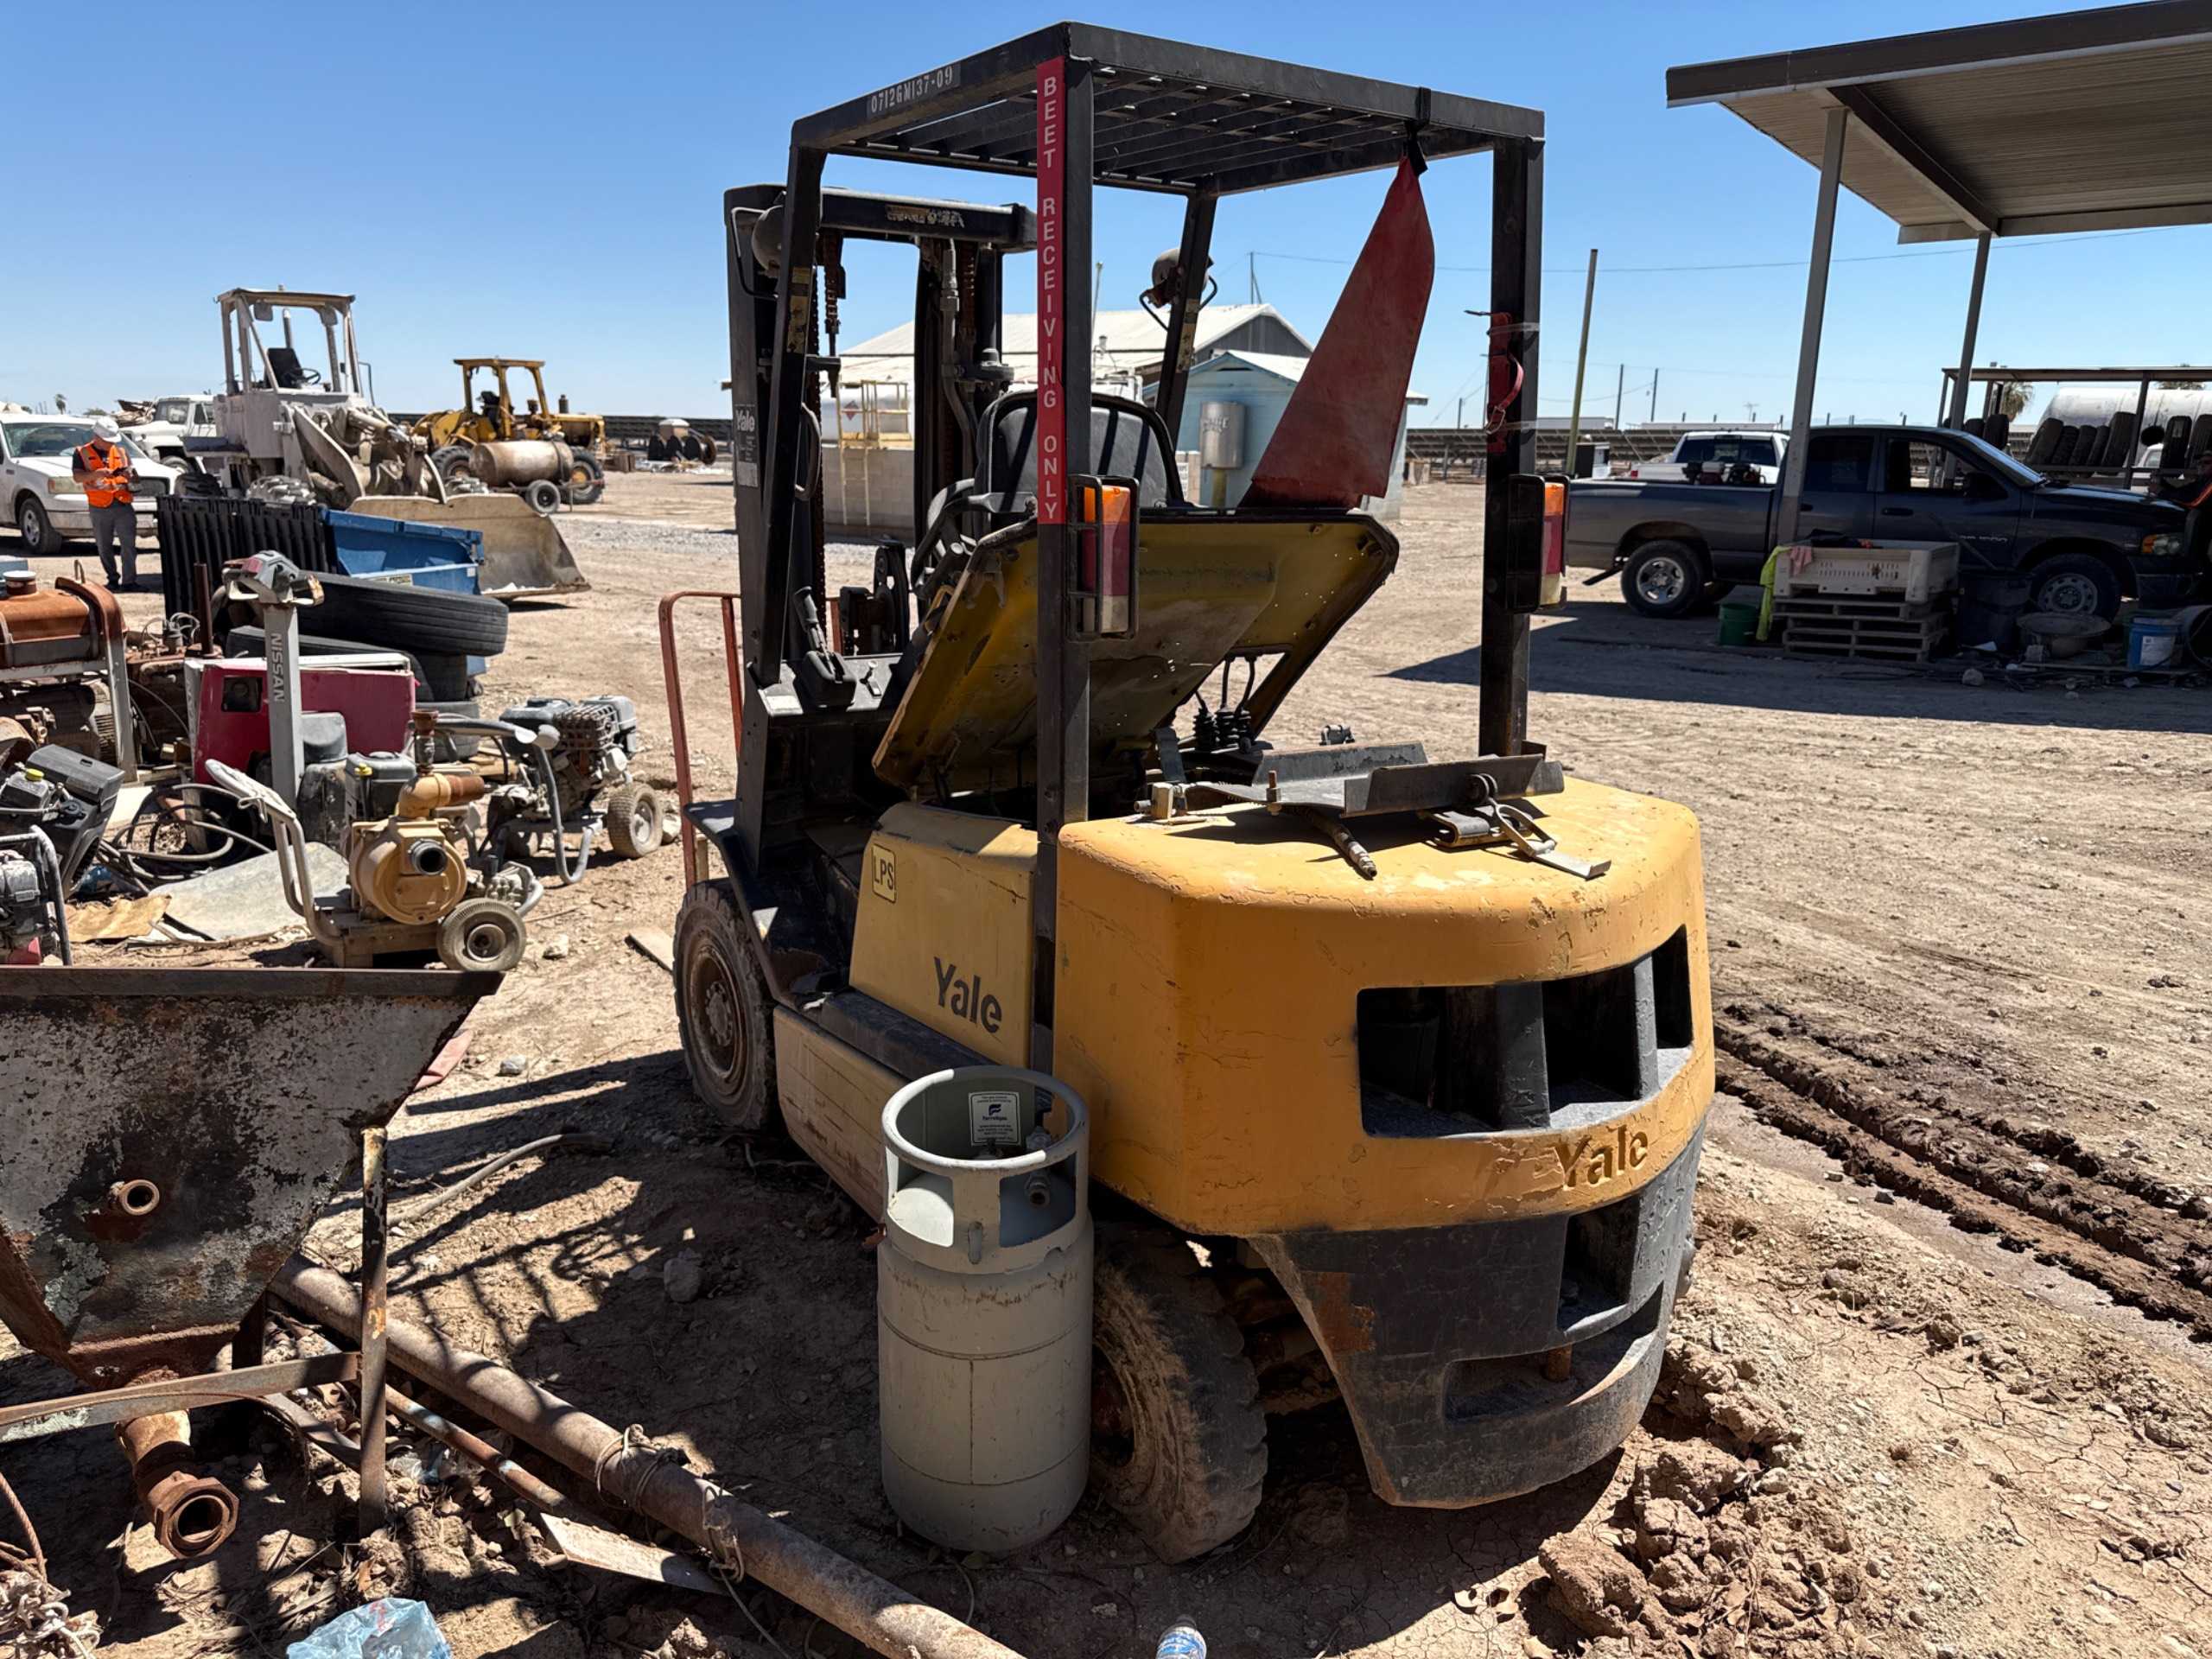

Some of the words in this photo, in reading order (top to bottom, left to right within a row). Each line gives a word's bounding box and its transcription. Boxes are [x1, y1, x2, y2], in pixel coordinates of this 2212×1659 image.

[1043, 76, 1057, 168] BEET
[1043, 197, 1057, 408] RECEIVING
[734, 409, 755, 432] Yale
[1044, 435, 1058, 519] ONLY
[270, 632, 285, 702] NISSAN
[874, 855, 894, 890] LPS
[933, 956, 1002, 1033] Yale
[1554, 1124, 1648, 1189] Yale
